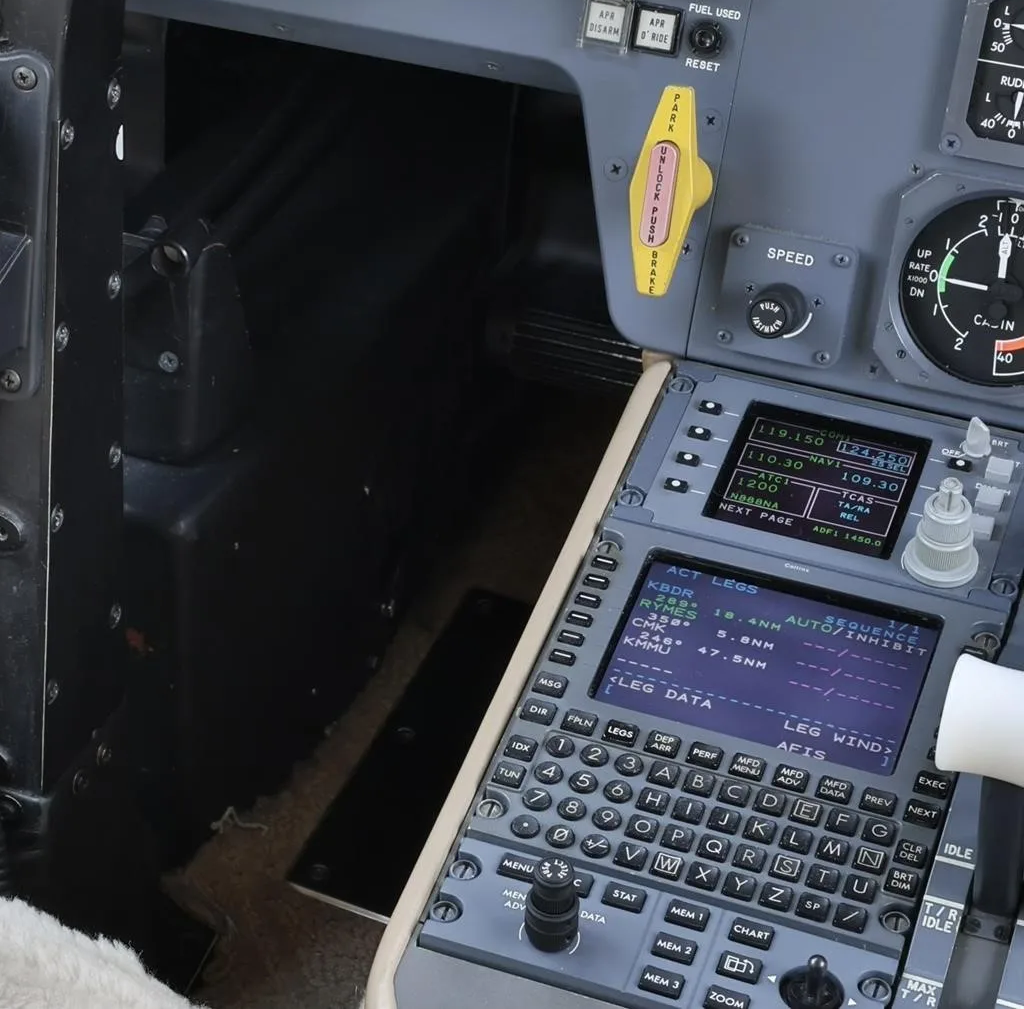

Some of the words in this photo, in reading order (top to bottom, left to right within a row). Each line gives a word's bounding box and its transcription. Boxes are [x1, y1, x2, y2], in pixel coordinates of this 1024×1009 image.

[599, 10, 615, 20] APR
[689, 3, 712, 15] FUEL
[716, 8, 741, 20] USED
[589, 23, 619, 35] DISARM
[649, 18, 665, 27] APR
[991, 42, 1005, 53] 50
[685, 58, 720, 72] RESET
[668, 93, 681, 132] PARK
[653, 146, 667, 201] UNLOCK
[647, 207, 658, 243] PUSH
[767, 248, 814, 266] SPEED
[917, 249, 932, 258] UP
[648, 250, 658, 295] BRAKE
[909, 262, 930, 272] RATE
[910, 287, 925, 298] DN
[759, 302, 780, 313] PUSH
[758, 425, 825, 446] 119.150
[747, 451, 804, 470] 110.30
[840, 443, 908, 465] 124.250
[737, 477, 779, 493] 1200
[842, 473, 899, 492] 109.30
[840, 491, 875, 504] TCAS
[719, 503, 753, 516] NEXT
[760, 512, 795, 527] PAGE
[667, 566, 702, 581] ACT
[711, 576, 759, 595] LEGS
[647, 581, 695, 599] KBDR
[640, 599, 698, 620] RYMES
[714, 608, 781, 631] 18.4NM
[825, 615, 920, 645] SEQUENCE
[716, 630, 775, 650] 5.8NM
[623, 636, 672, 655] KMMU
[698, 646, 768, 669] 47.5NM
[539, 678, 562, 689] MSG
[529, 705, 548, 715] DIR
[567, 715, 594, 727] FPLN
[607, 726, 634, 738] LEGS
[692, 749, 718, 760] PERF
[777, 742, 827, 761] AFIS
[919, 777, 947, 789] EXEC
[865, 795, 892, 807] PREV
[908, 806, 937, 819] NEXT
[902, 843, 922, 854] CLR
[944, 843, 974, 859] IDLE
[612, 890, 637, 903] STAT
[580, 911, 606, 924] DATA
[671, 906, 696, 919] MEM
[699, 913, 703, 921] 1
[733, 924, 771, 940] CHART
[657, 940, 682, 953] MEM
[685, 946, 692, 955] 2
